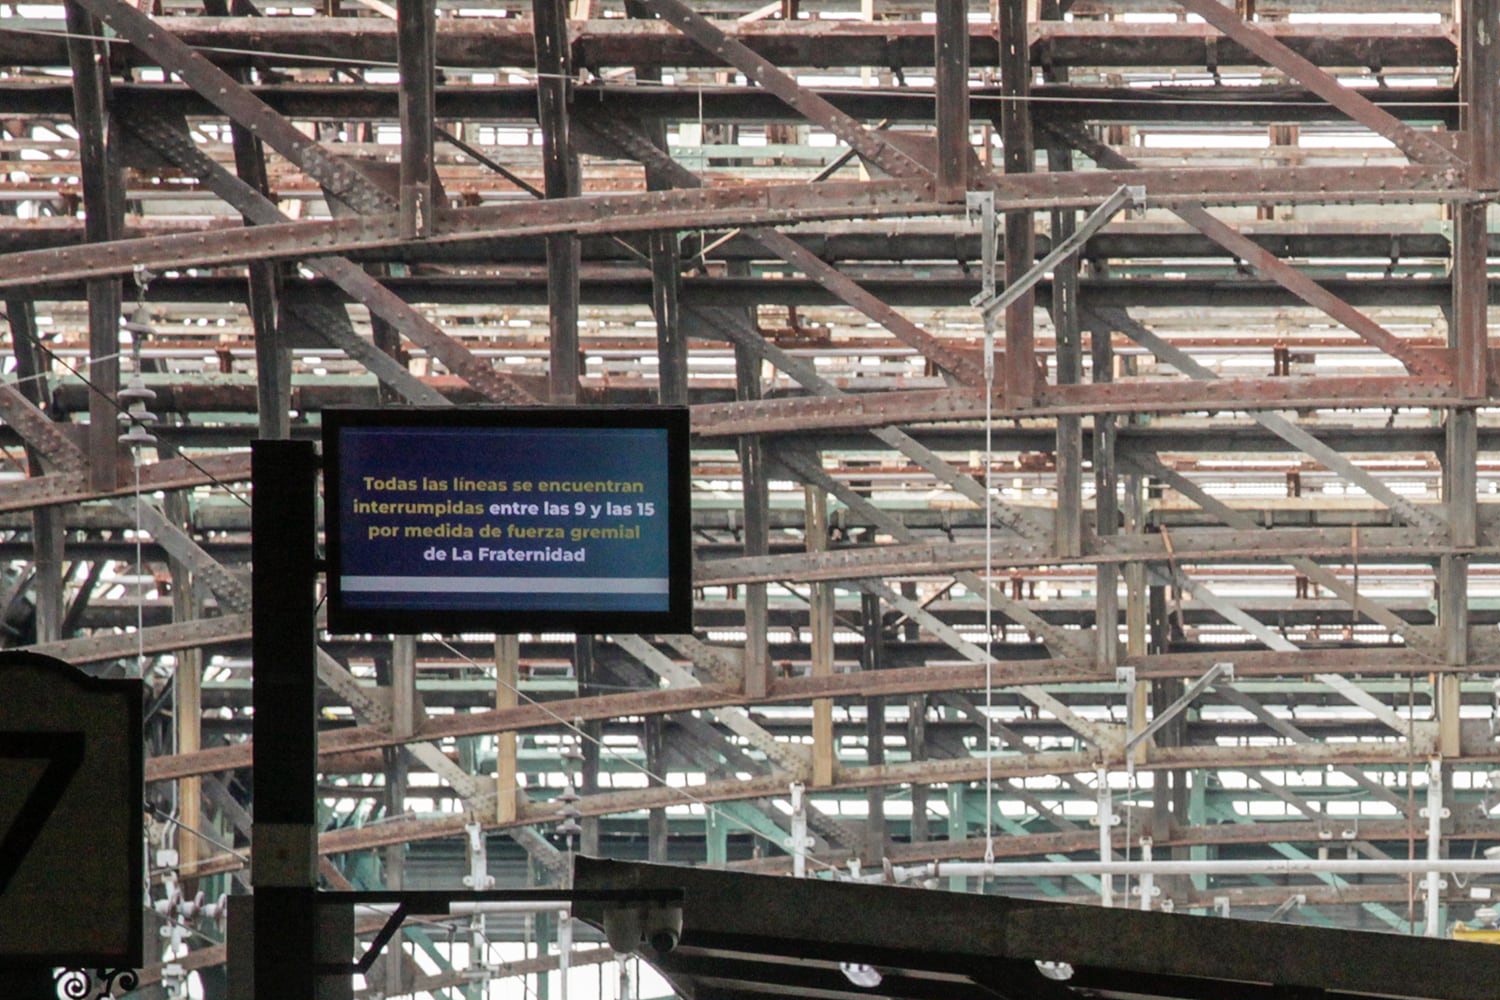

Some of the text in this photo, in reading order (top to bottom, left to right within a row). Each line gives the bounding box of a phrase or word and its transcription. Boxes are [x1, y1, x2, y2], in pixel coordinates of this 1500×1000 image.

[363, 476, 644, 493] Todas las líneas se encuentran
[353, 498, 655, 519] interrumpidas entre las 9 y las 15
[368, 523, 641, 541] por medida de fuerza gremial
[423, 546, 586, 562] de La Fraternidad
